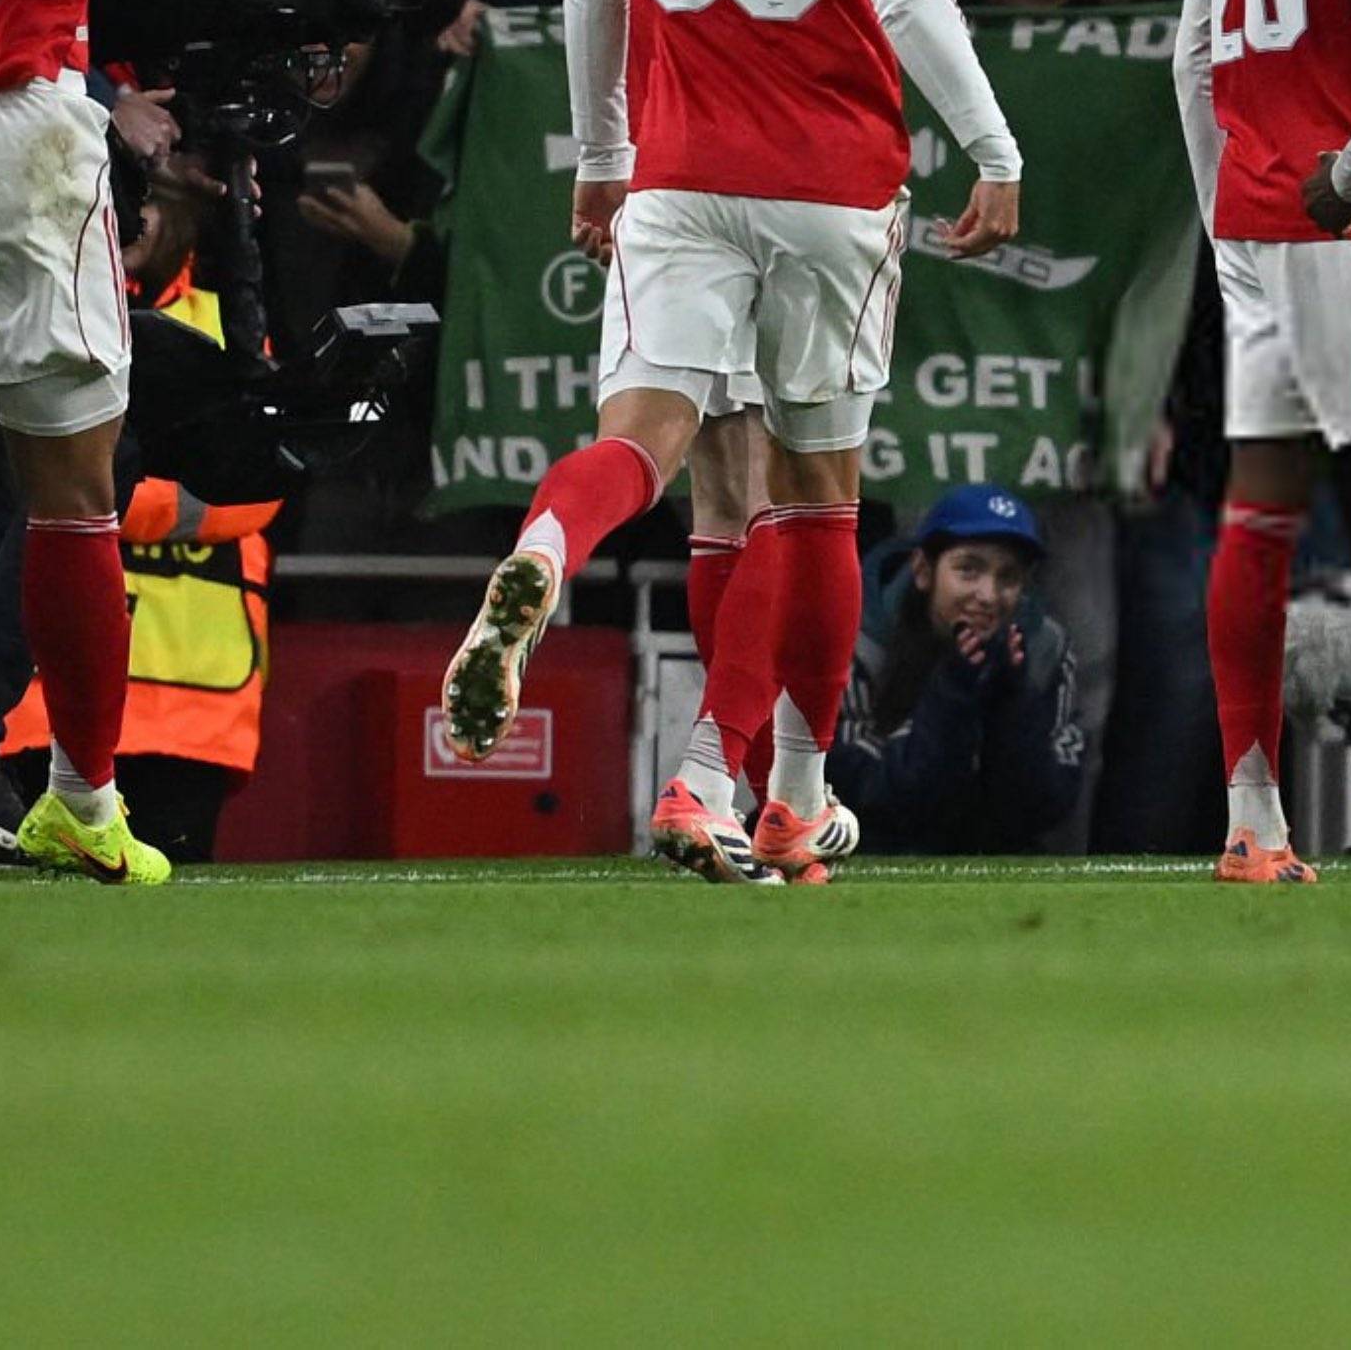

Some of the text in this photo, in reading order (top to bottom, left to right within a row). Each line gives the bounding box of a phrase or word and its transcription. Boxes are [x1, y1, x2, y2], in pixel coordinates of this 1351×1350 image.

[465, 359, 484, 410] I
[915, 353, 1061, 410] GET
[928, 432, 998, 483] IT
